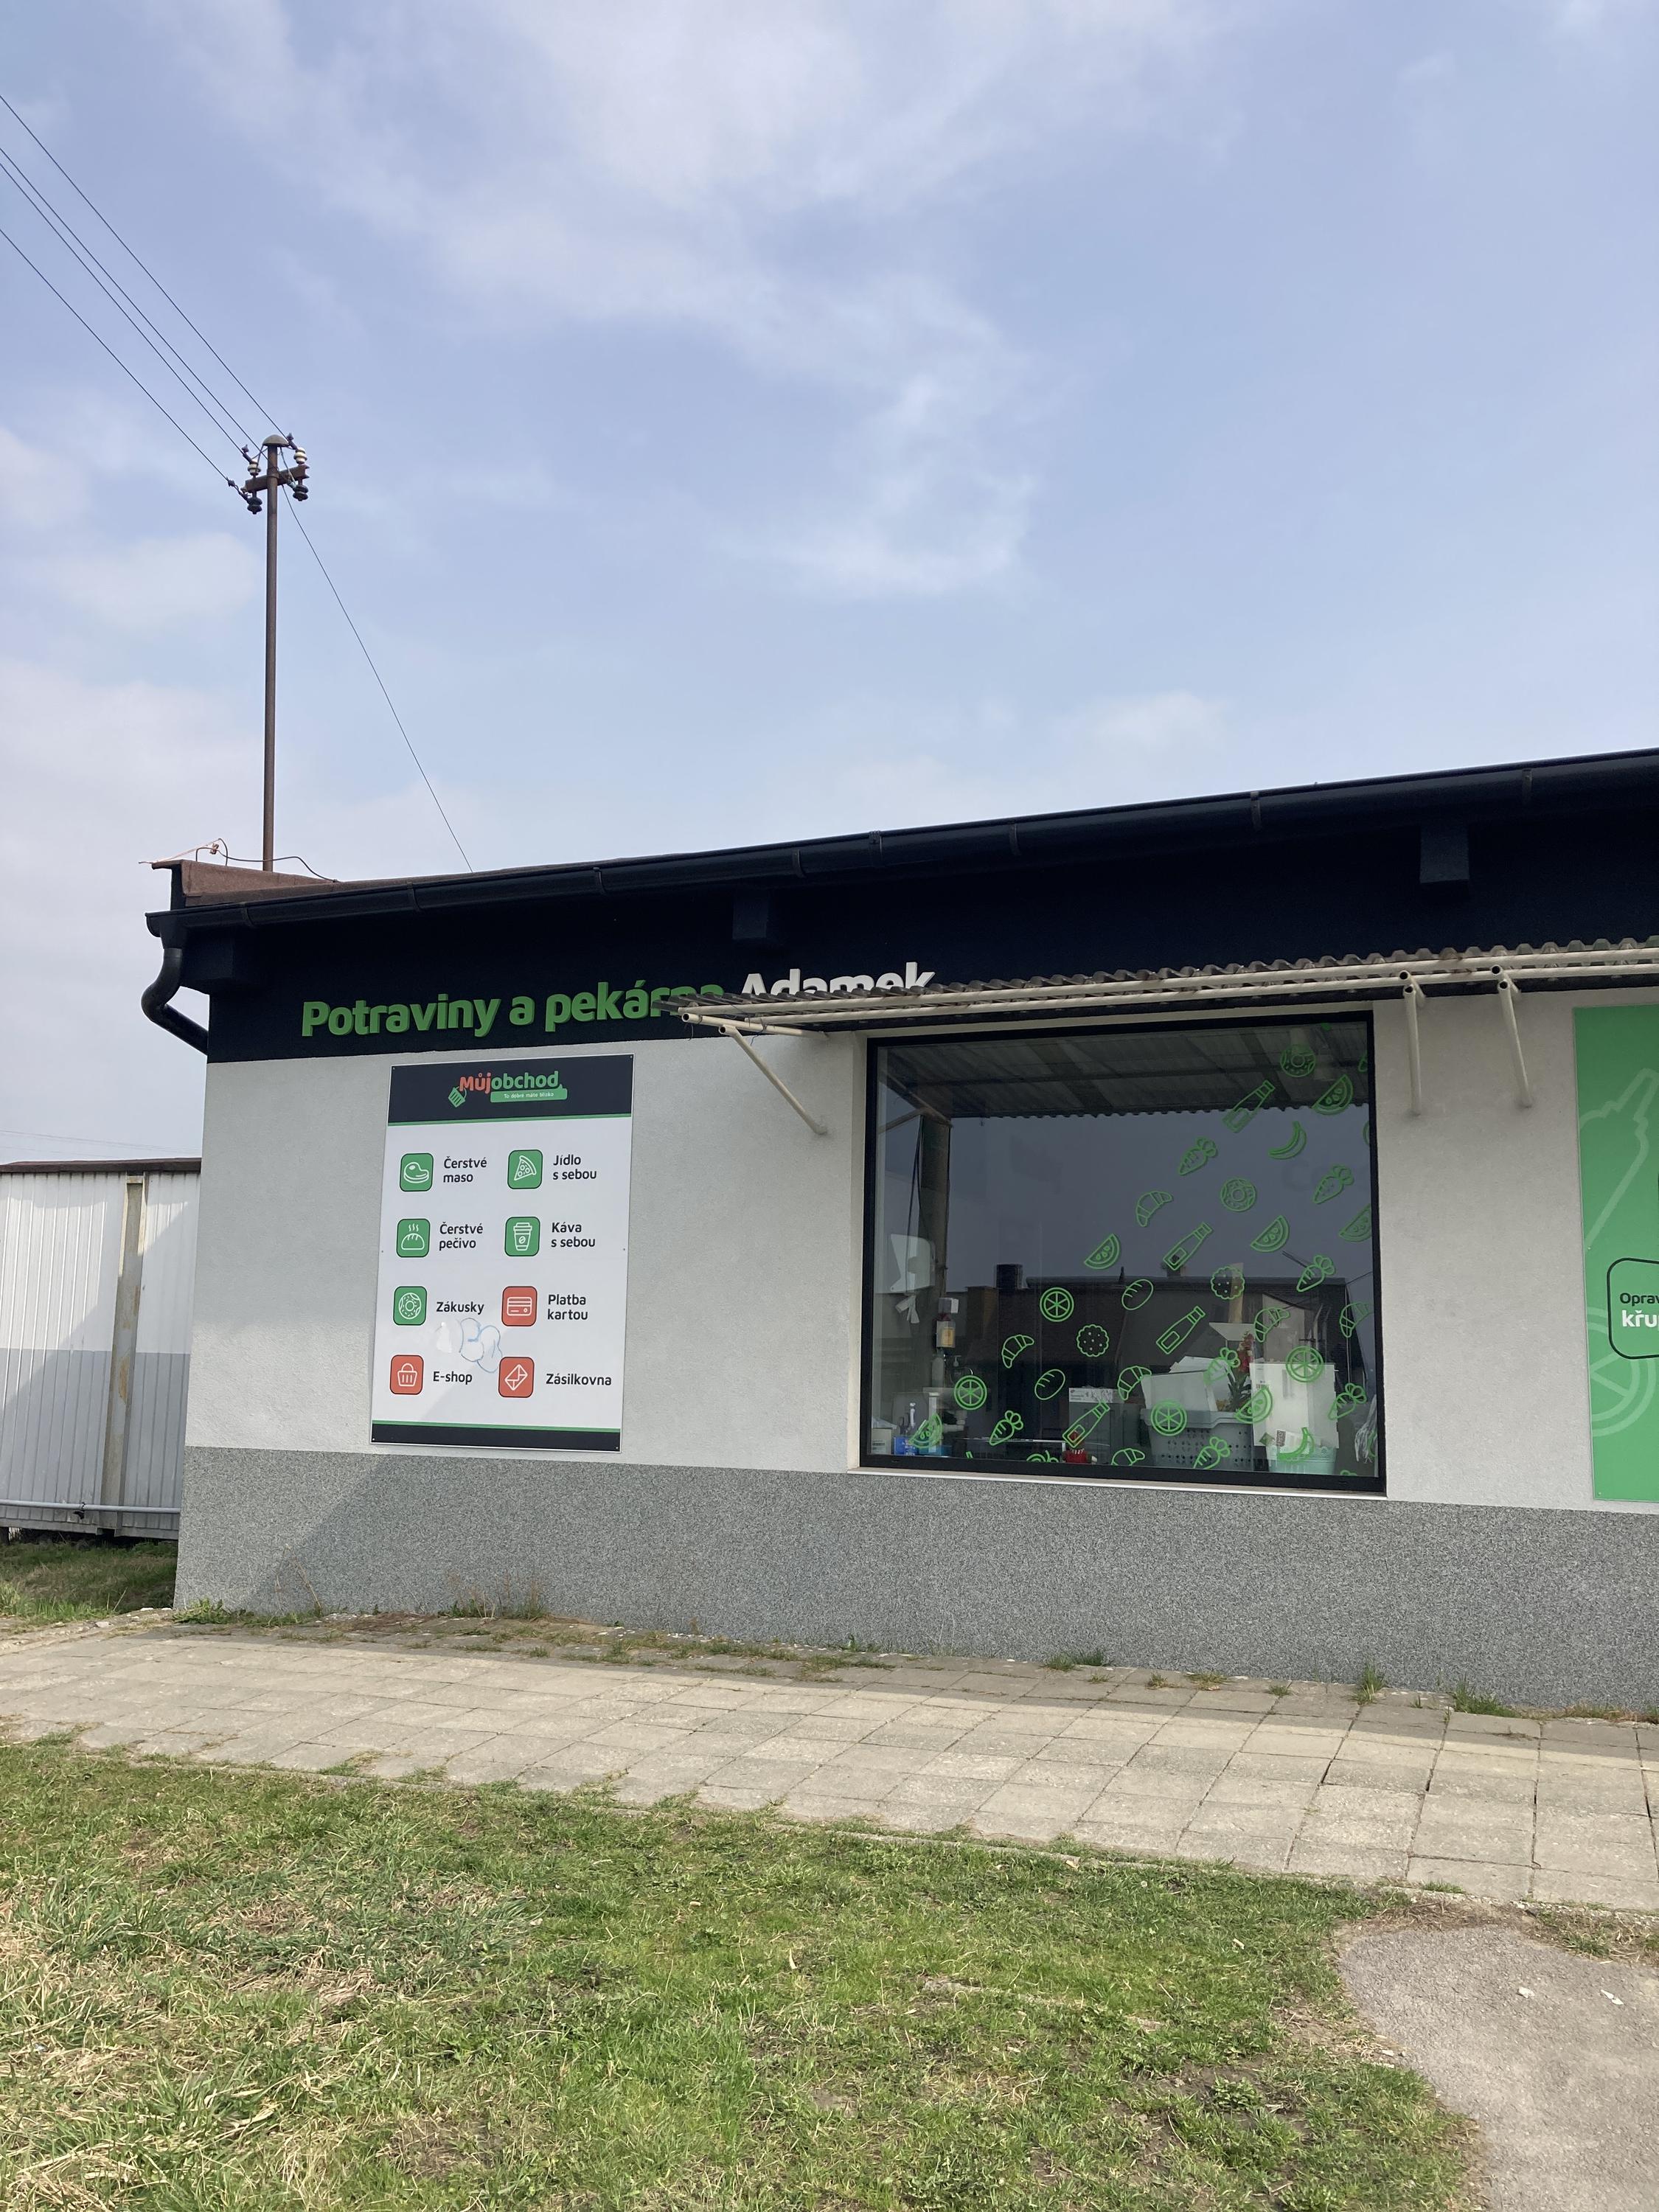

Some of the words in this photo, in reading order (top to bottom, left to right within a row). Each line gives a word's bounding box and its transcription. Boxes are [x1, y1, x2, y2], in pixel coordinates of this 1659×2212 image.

[302, 993, 501, 1037] Potraviny
[509, 995, 535, 1026] a
[443, 1156, 487, 1169] Čerstvé
[552, 1155, 582, 1166] Jídlo
[442, 1172, 473, 1183] maso
[552, 1172, 559, 1180] s
[561, 1169, 597, 1180] sebou
[439, 1222, 484, 1235] Čerstvé
[552, 1222, 582, 1233] Káva
[439, 1237, 476, 1251] pečivo
[551, 1239, 557, 1248] s
[560, 1237, 596, 1248] sebou
[548, 1294, 587, 1306] Platba
[436, 1301, 484, 1315] Zákusky
[547, 1309, 588, 1320] kartou
[1622, 1310, 1659, 1331] křu
[433, 1371, 473, 1384] E-shop
[546, 1373, 612, 1385] Zásilkovna
